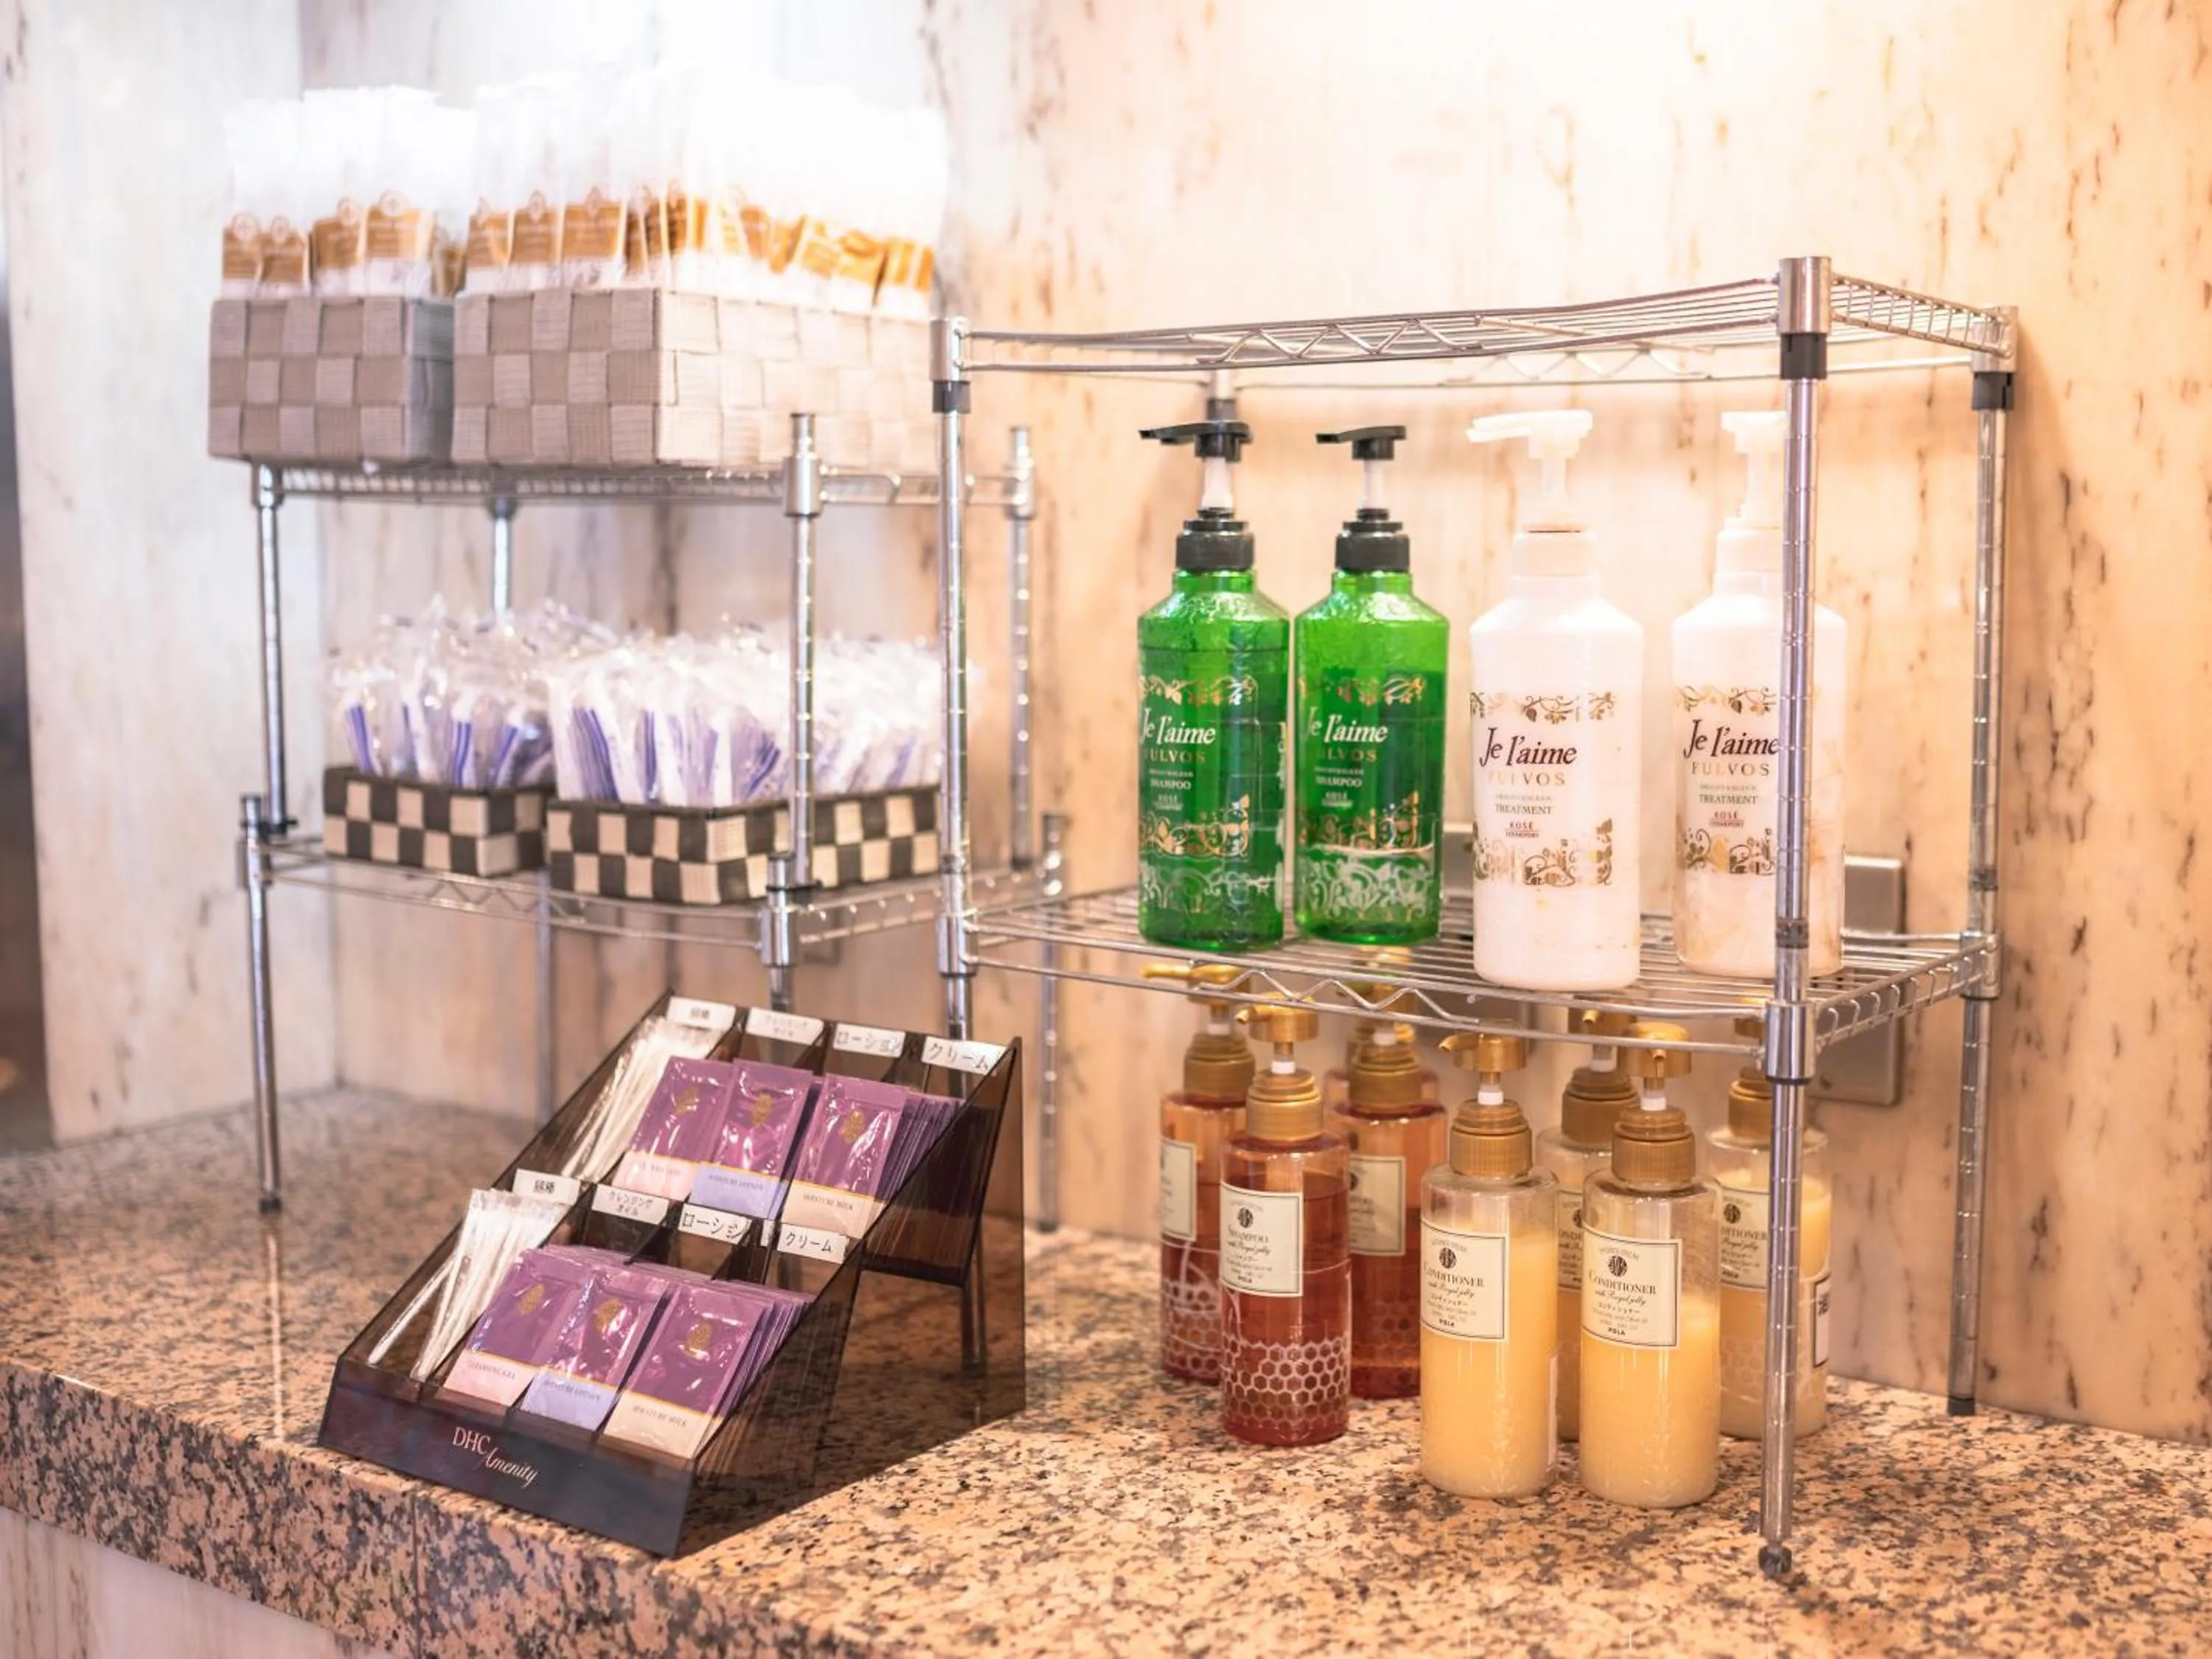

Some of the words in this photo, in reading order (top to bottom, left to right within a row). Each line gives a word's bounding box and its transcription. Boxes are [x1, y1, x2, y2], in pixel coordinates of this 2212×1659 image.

[1156, 715, 1216, 745] l'aime
[1324, 713, 1388, 743] l'aime
[1685, 719, 1708, 759] Je
[1711, 726, 1779, 757] l'aime
[1479, 727, 1503, 768] Je
[1506, 736, 1578, 766] l'aime
[1495, 804, 1554, 815] TREATMENT
[1699, 794, 1759, 804] TREATMENT
[929, 1043, 989, 1071] クリーム
[785, 1231, 832, 1253] クリーム
[453, 1427, 491, 1455] DHC
